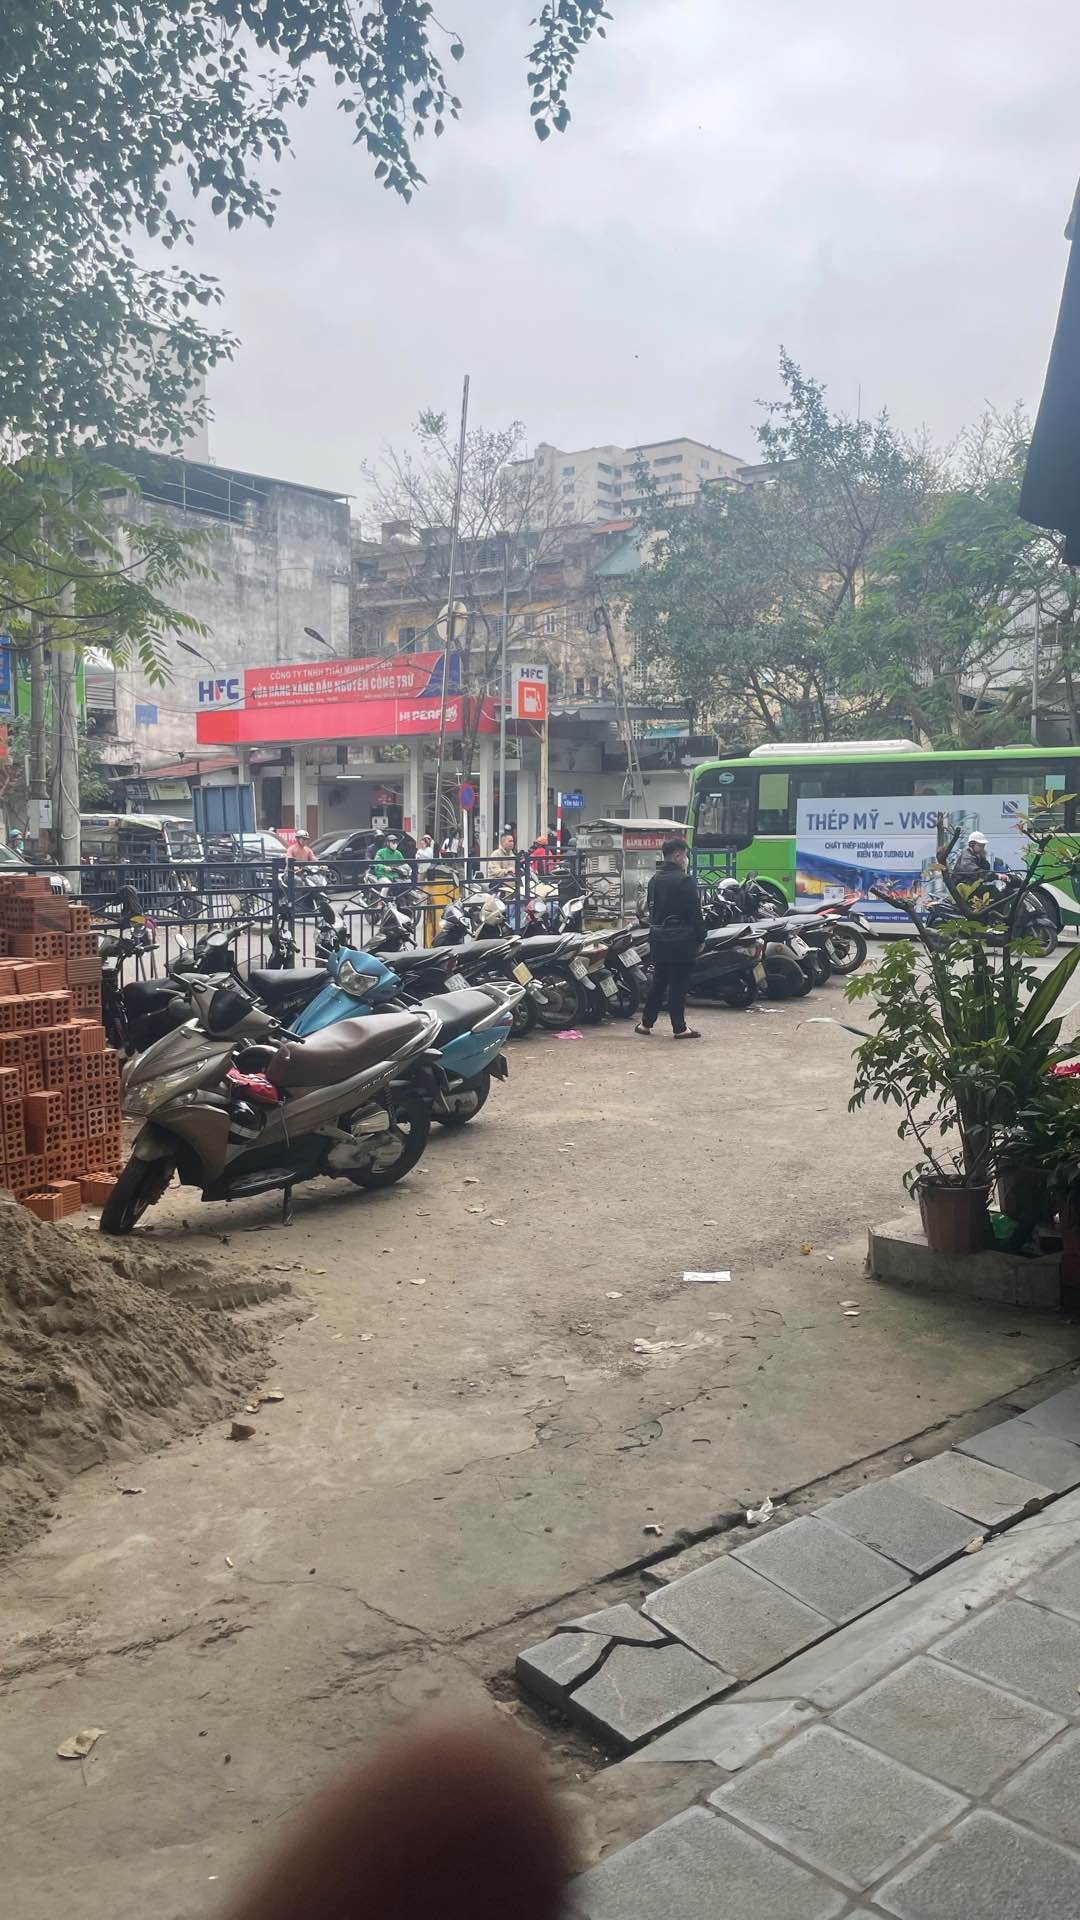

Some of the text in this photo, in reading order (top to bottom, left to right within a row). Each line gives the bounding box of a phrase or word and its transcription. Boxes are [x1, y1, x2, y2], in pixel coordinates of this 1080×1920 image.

[293, 670, 304, 679] TY
[520, 667, 544, 680] HFC
[198, 678, 239, 702] HFC
[806, 809, 849, 831] THÉP
[853, 808, 879, 830] MỸ
